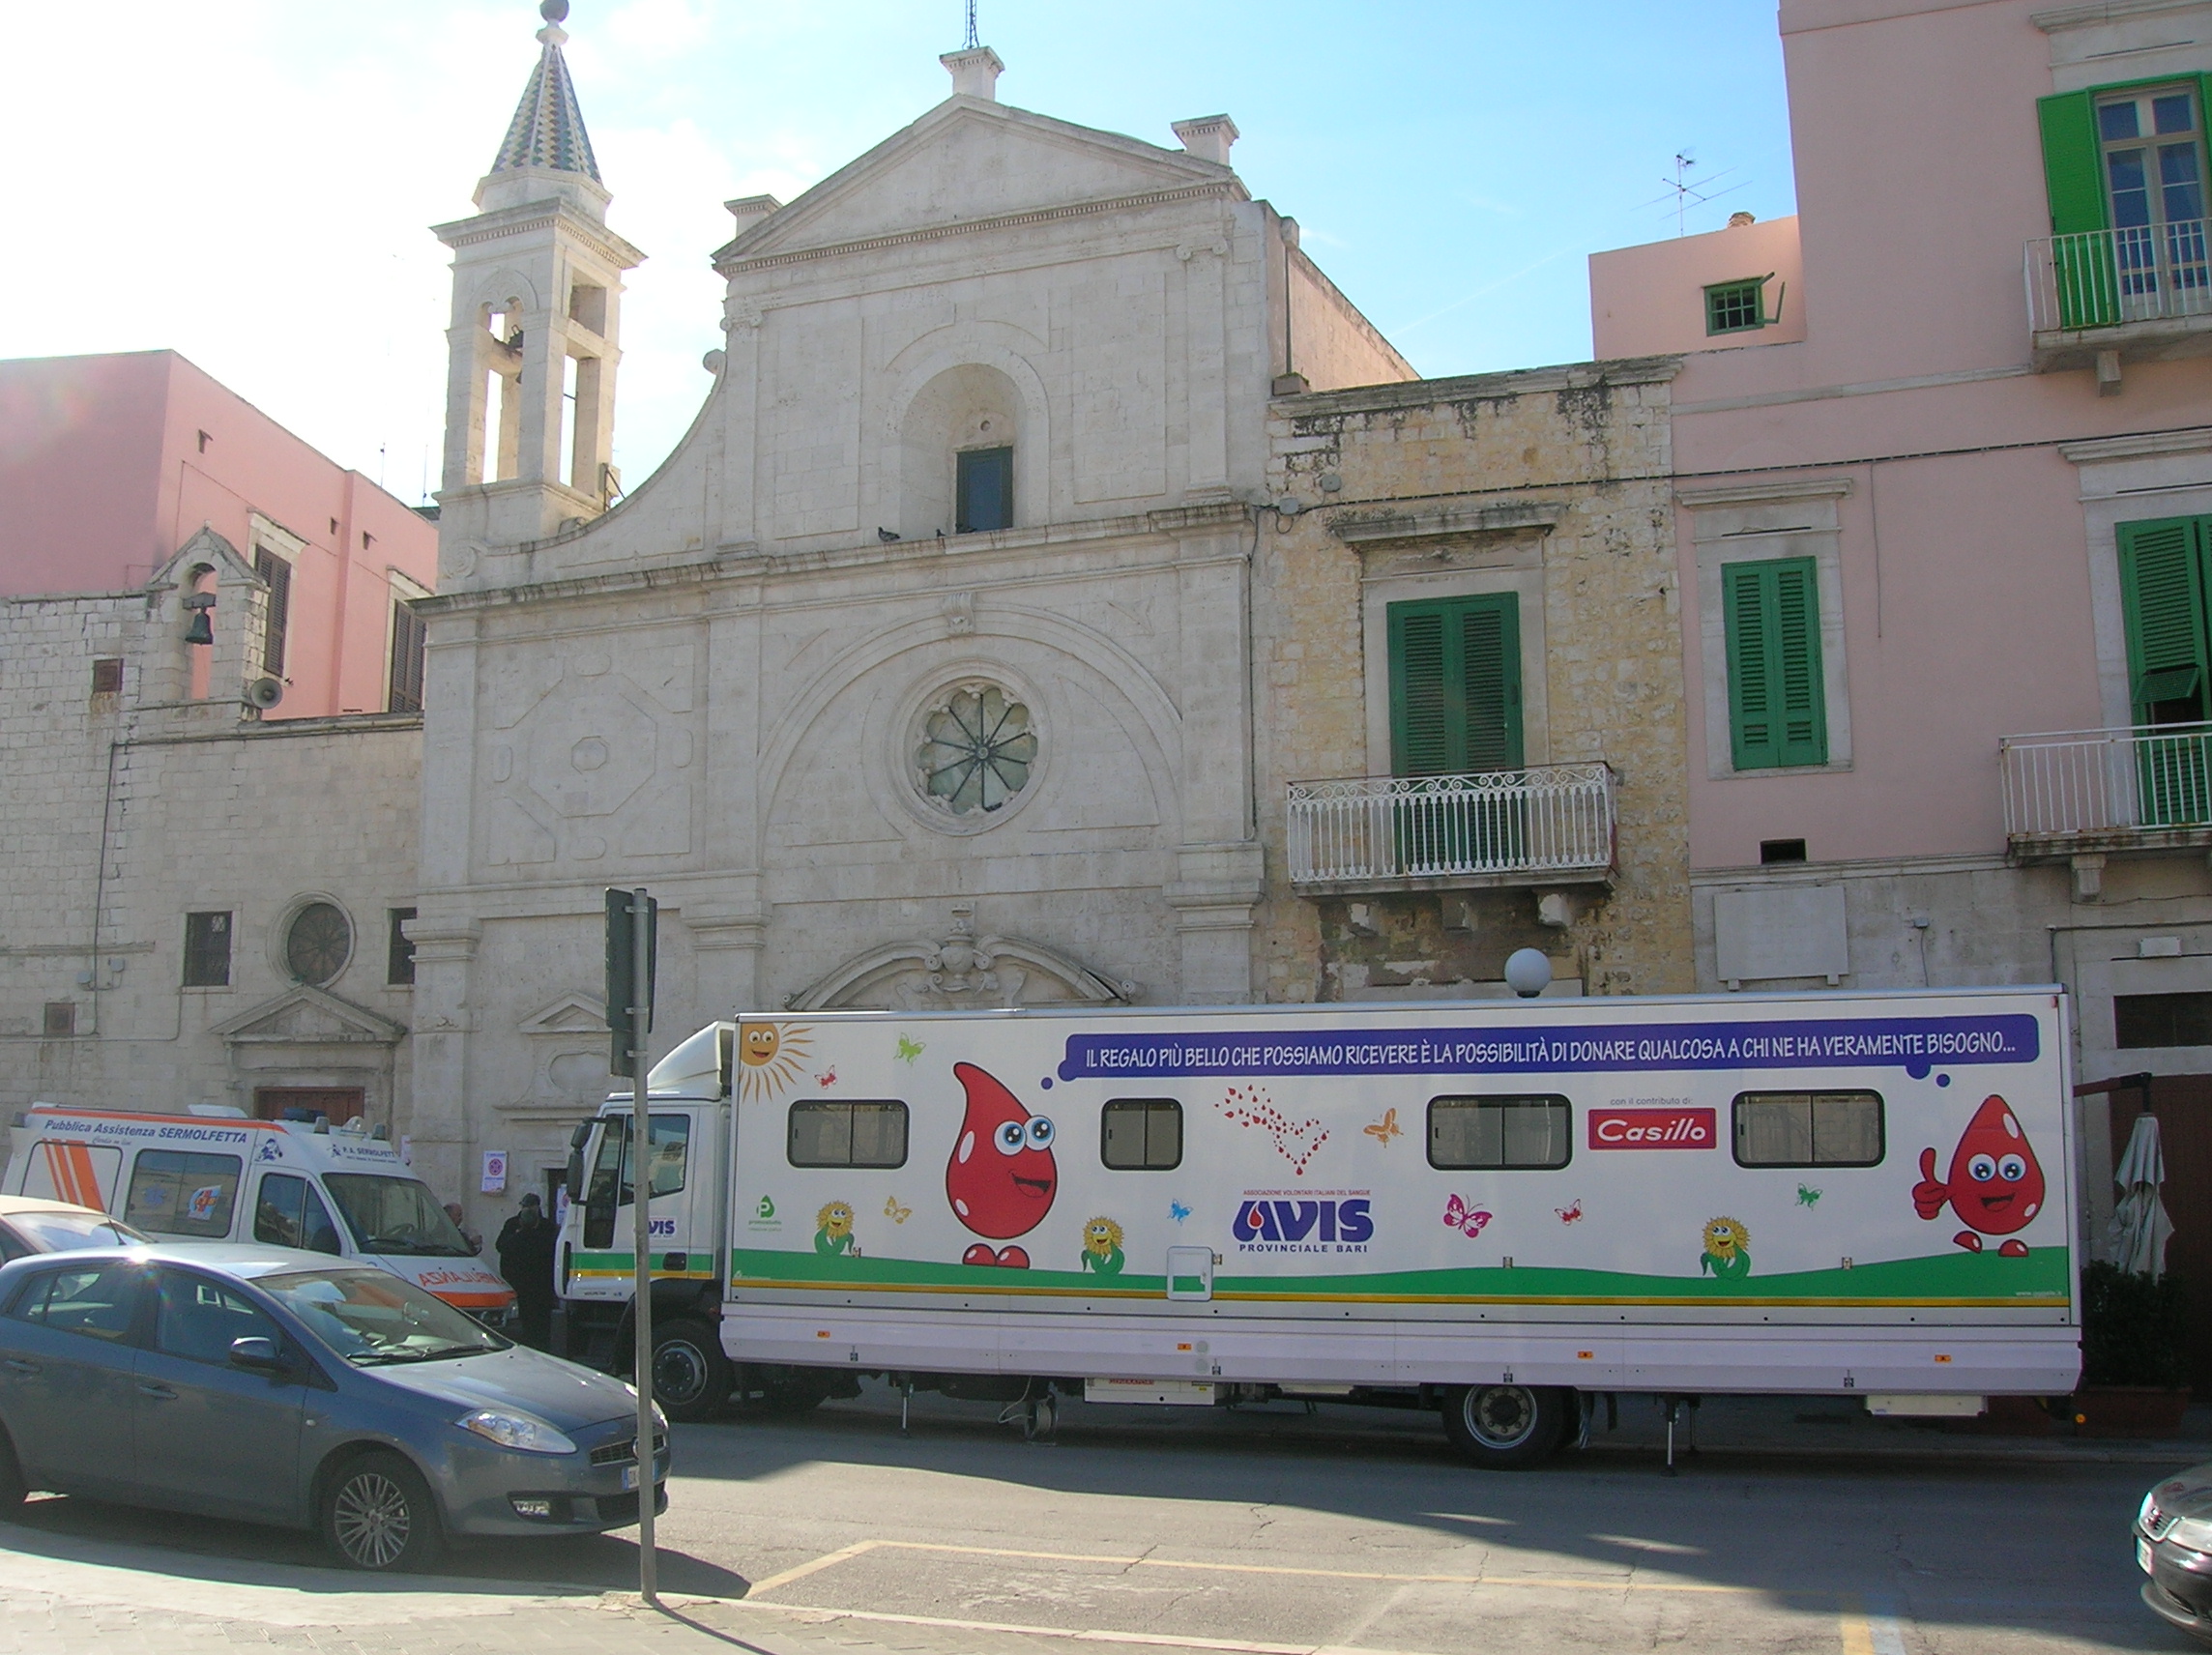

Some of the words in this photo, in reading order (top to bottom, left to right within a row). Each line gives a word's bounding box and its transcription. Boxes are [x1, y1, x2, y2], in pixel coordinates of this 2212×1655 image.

[1086, 1049, 1097, 1067] IL
[1099, 1047, 1157, 1068] REGALO
[1159, 1042, 1181, 1067] PIÙ
[1185, 1047, 1229, 1066] BELLO
[1232, 1046, 1260, 1066] CHE
[1264, 1044, 1343, 1066] POSSIAMO
[1346, 1043, 1418, 1064] RICEVERE
[1421, 1039, 1431, 1064] È
[1434, 1044, 1452, 1063] LA
[1455, 1036, 1548, 1063] POSSIBILITÀ
[1553, 1041, 1567, 1062] DI
[1570, 1040, 1635, 1062] DONARE
[1639, 1038, 1726, 1061] QUALCOSA
[1727, 1037, 1740, 1059] A
[1742, 1037, 1769, 1059] CHI
[1772, 1036, 1794, 1059] NE
[1797, 1035, 1821, 1057] HA
[1823, 1033, 1924, 1057] VERAMENTE
[1927, 1031, 2016, 1055] BISOGNO...
[1636, 1096, 1680, 1105] contributo
[44, 1118, 92, 1133] Pubblica
[94, 1122, 156, 1138] Assistenza
[159, 1126, 247, 1144] SERMOLFETTA
[1597, 1118, 1706, 1141] Casillo
[649, 1221, 675, 1234] VIS
[1233, 1199, 1374, 1242] AVIS
